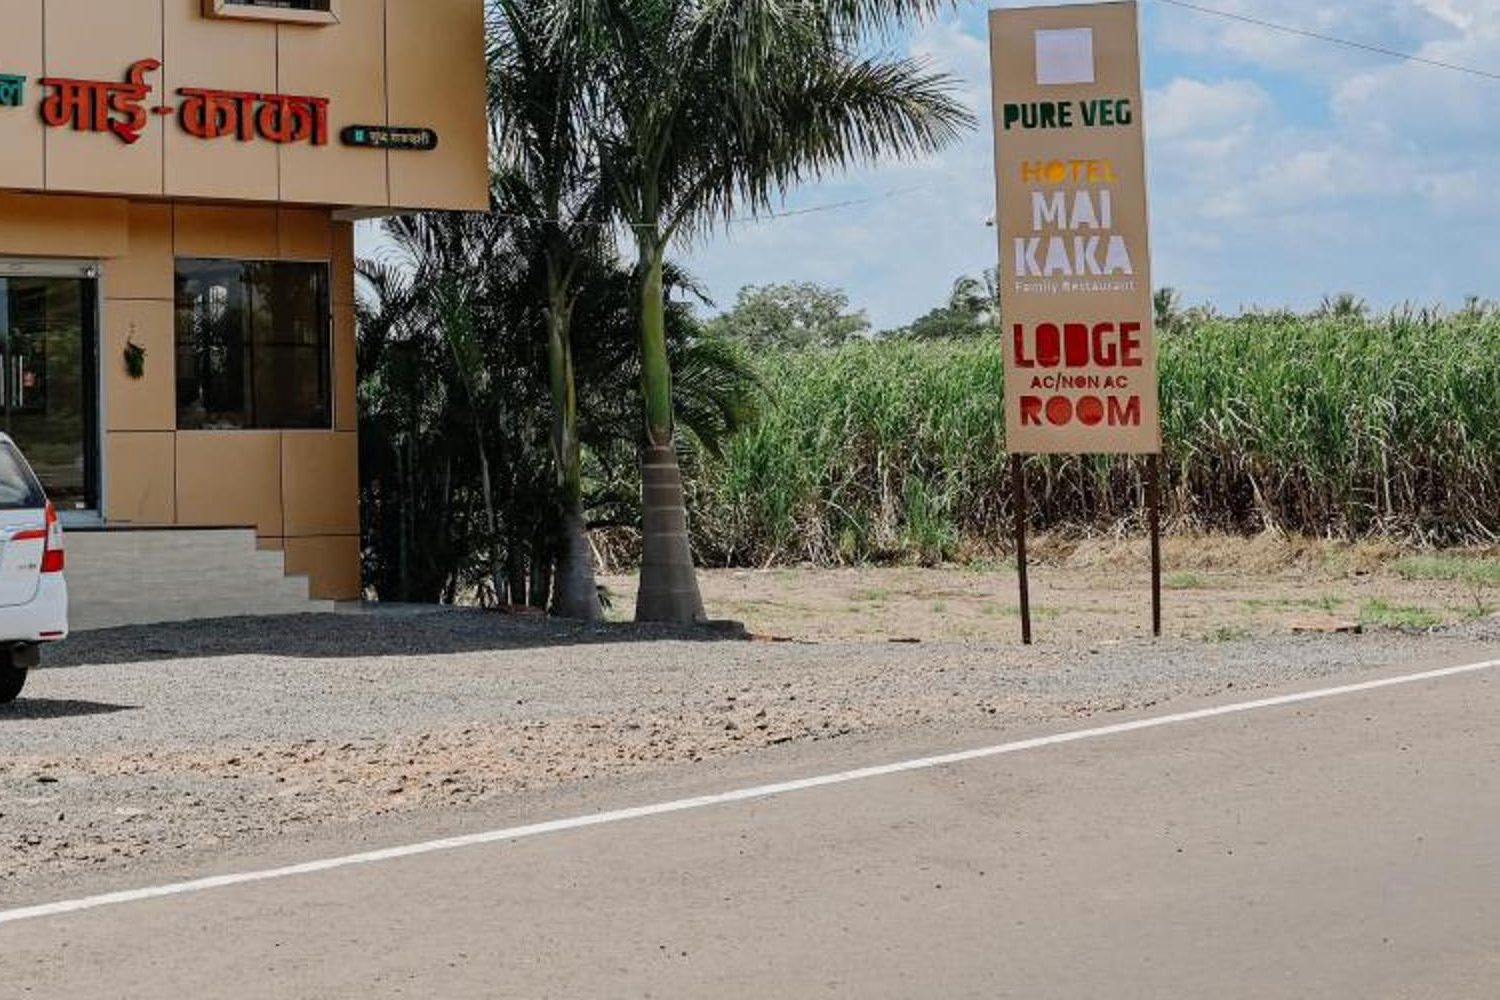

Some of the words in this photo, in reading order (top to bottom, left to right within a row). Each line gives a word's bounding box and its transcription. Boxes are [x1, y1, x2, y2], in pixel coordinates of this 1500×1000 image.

[1003, 101, 1073, 130] PURE
[1080, 99, 1132, 127] VEG
[1021, 159, 1121, 184] HOTEL
[1031, 189, 1112, 231] MAI
[1013, 235, 1134, 277] KAKA
[1015, 281, 1057, 294] Family
[1062, 281, 1134, 293] Restaurant
[1013, 322, 1143, 368] LODGE
[1030, 372, 1099, 392] AC/NON
[1103, 375, 1128, 389] AC
[1019, 395, 1141, 426] ROOM
